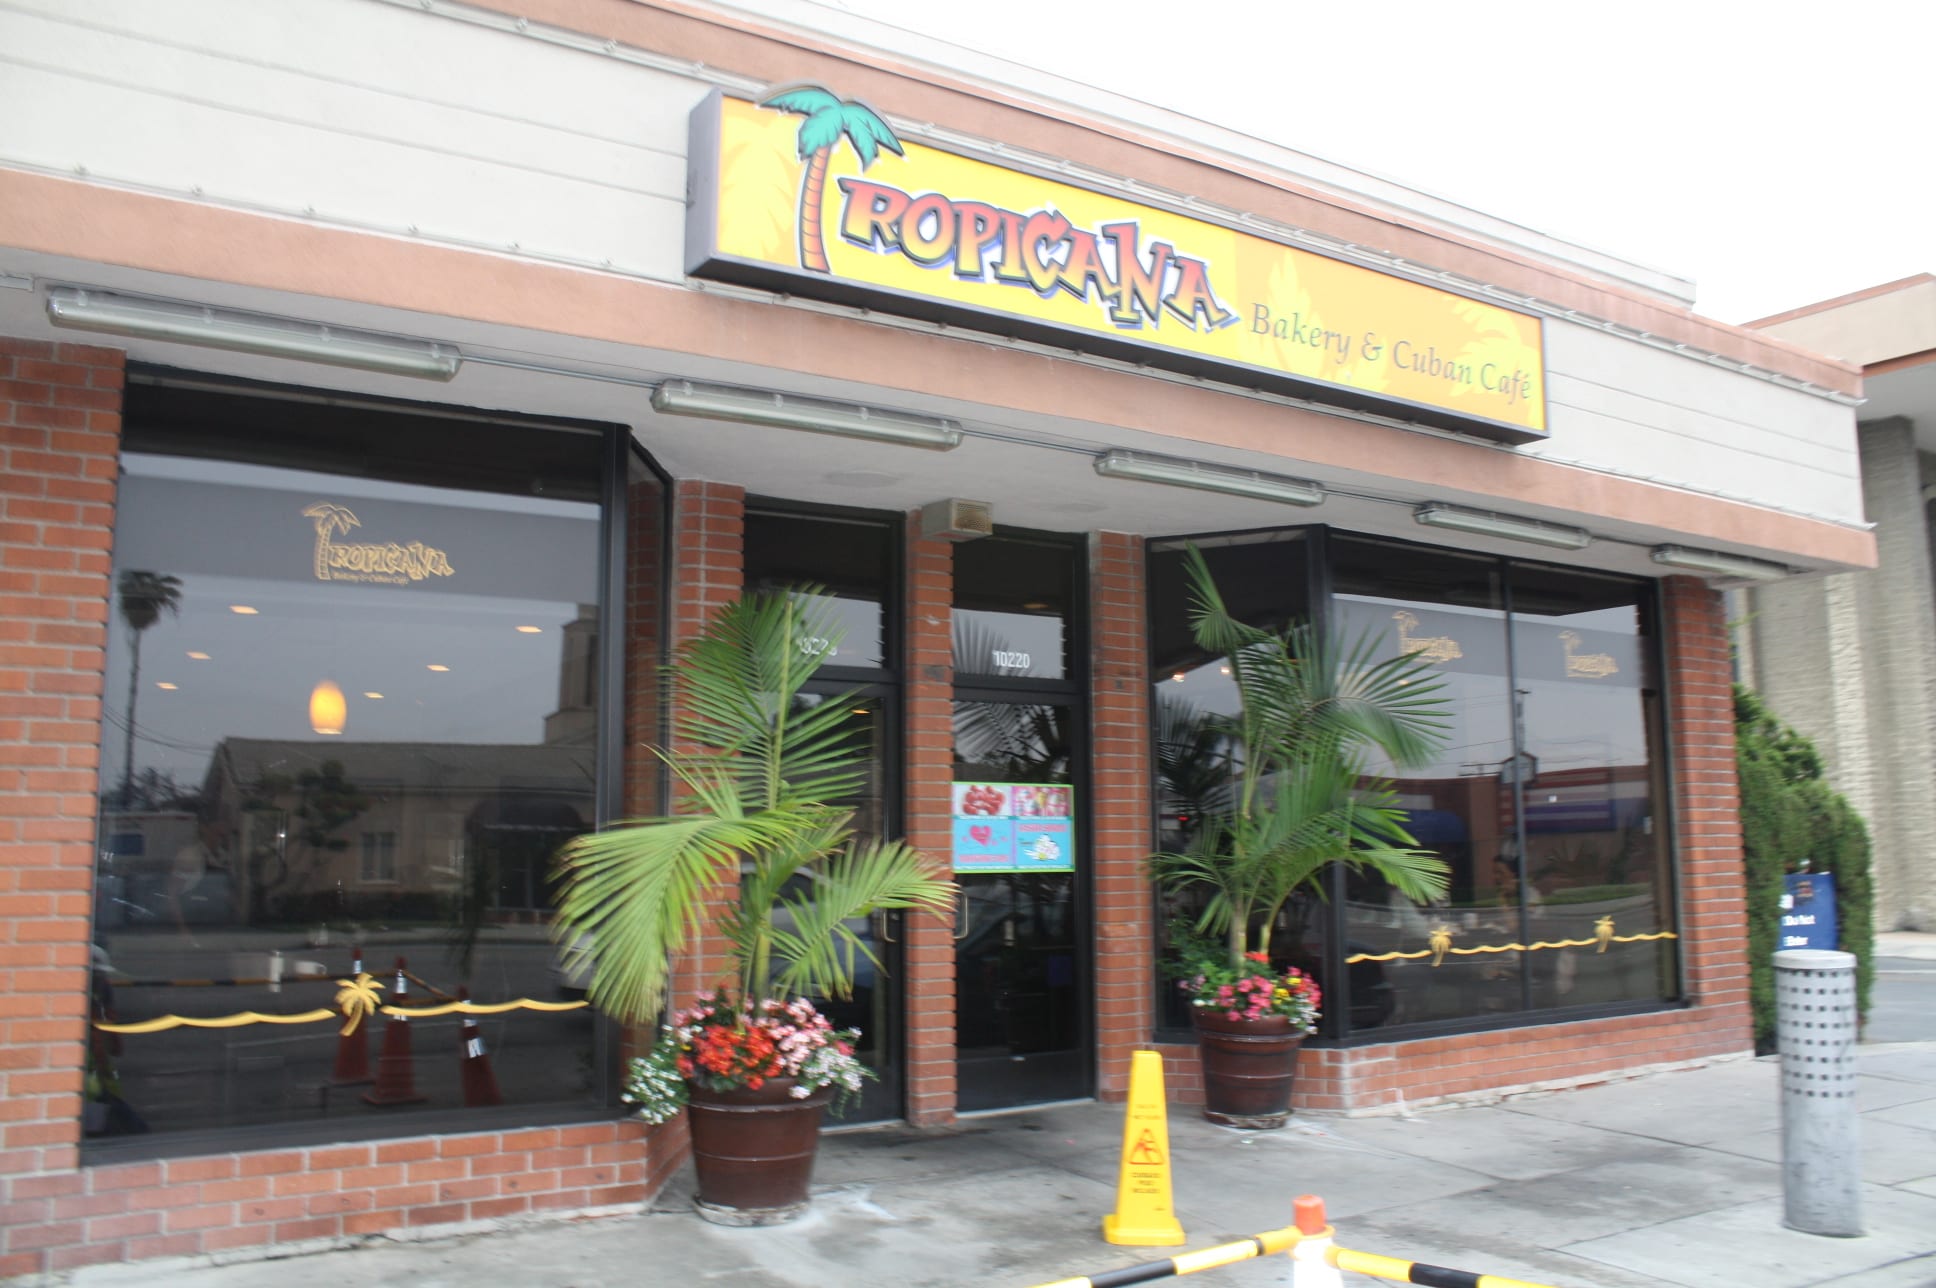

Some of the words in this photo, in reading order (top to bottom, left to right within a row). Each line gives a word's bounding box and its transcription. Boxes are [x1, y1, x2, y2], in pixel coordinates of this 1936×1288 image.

[1250, 302, 1351, 364] Bakery
[1361, 332, 1382, 361] &
[1393, 340, 1473, 385] Cuban
[1480, 363, 1531, 405] Café
[992, 650, 1031, 668] 10220
